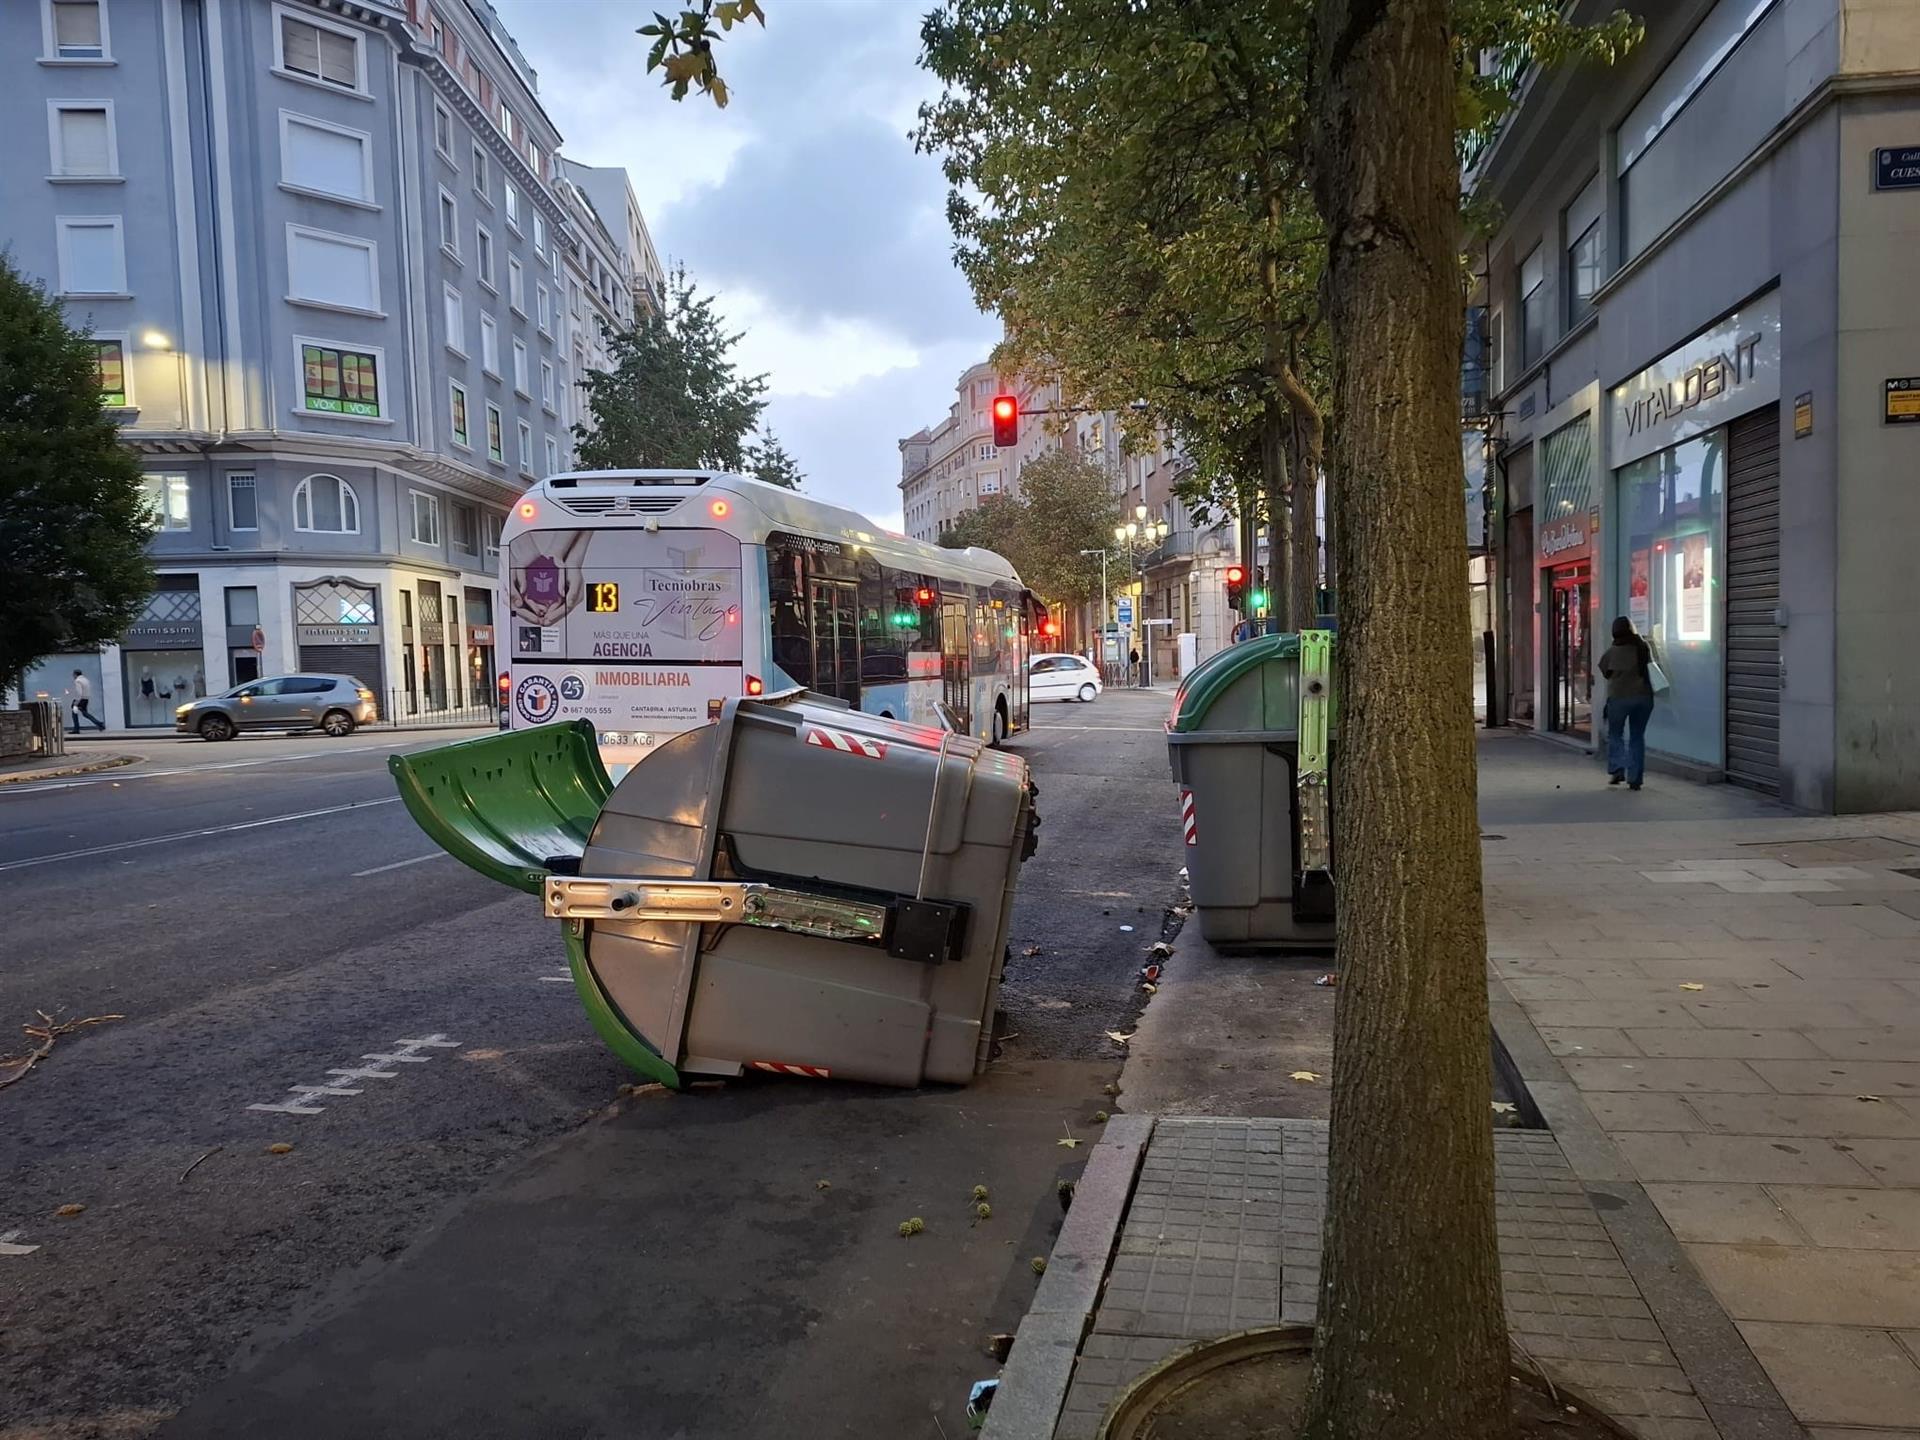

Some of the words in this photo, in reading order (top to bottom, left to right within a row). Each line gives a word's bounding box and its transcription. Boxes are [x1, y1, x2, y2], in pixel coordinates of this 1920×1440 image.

[1624, 332, 1762, 437] VITALDENT
[313, 399, 336, 410] VOX
[349, 402, 372, 414] VOX
[649, 579, 721, 592] Tecniobras
[595, 583, 617, 612] 13
[633, 596, 738, 641] Vintage
[126, 626, 195, 635] intimissimi
[614, 631, 631, 640] QUE
[632, 631, 650, 640] UNA
[593, 642, 653, 657] AGENCIA
[595, 671, 691, 687] INMOBILIARIA
[563, 680, 582, 698] 25
[604, 734, 629, 745] 0633
[633, 735, 653, 746] KCG
